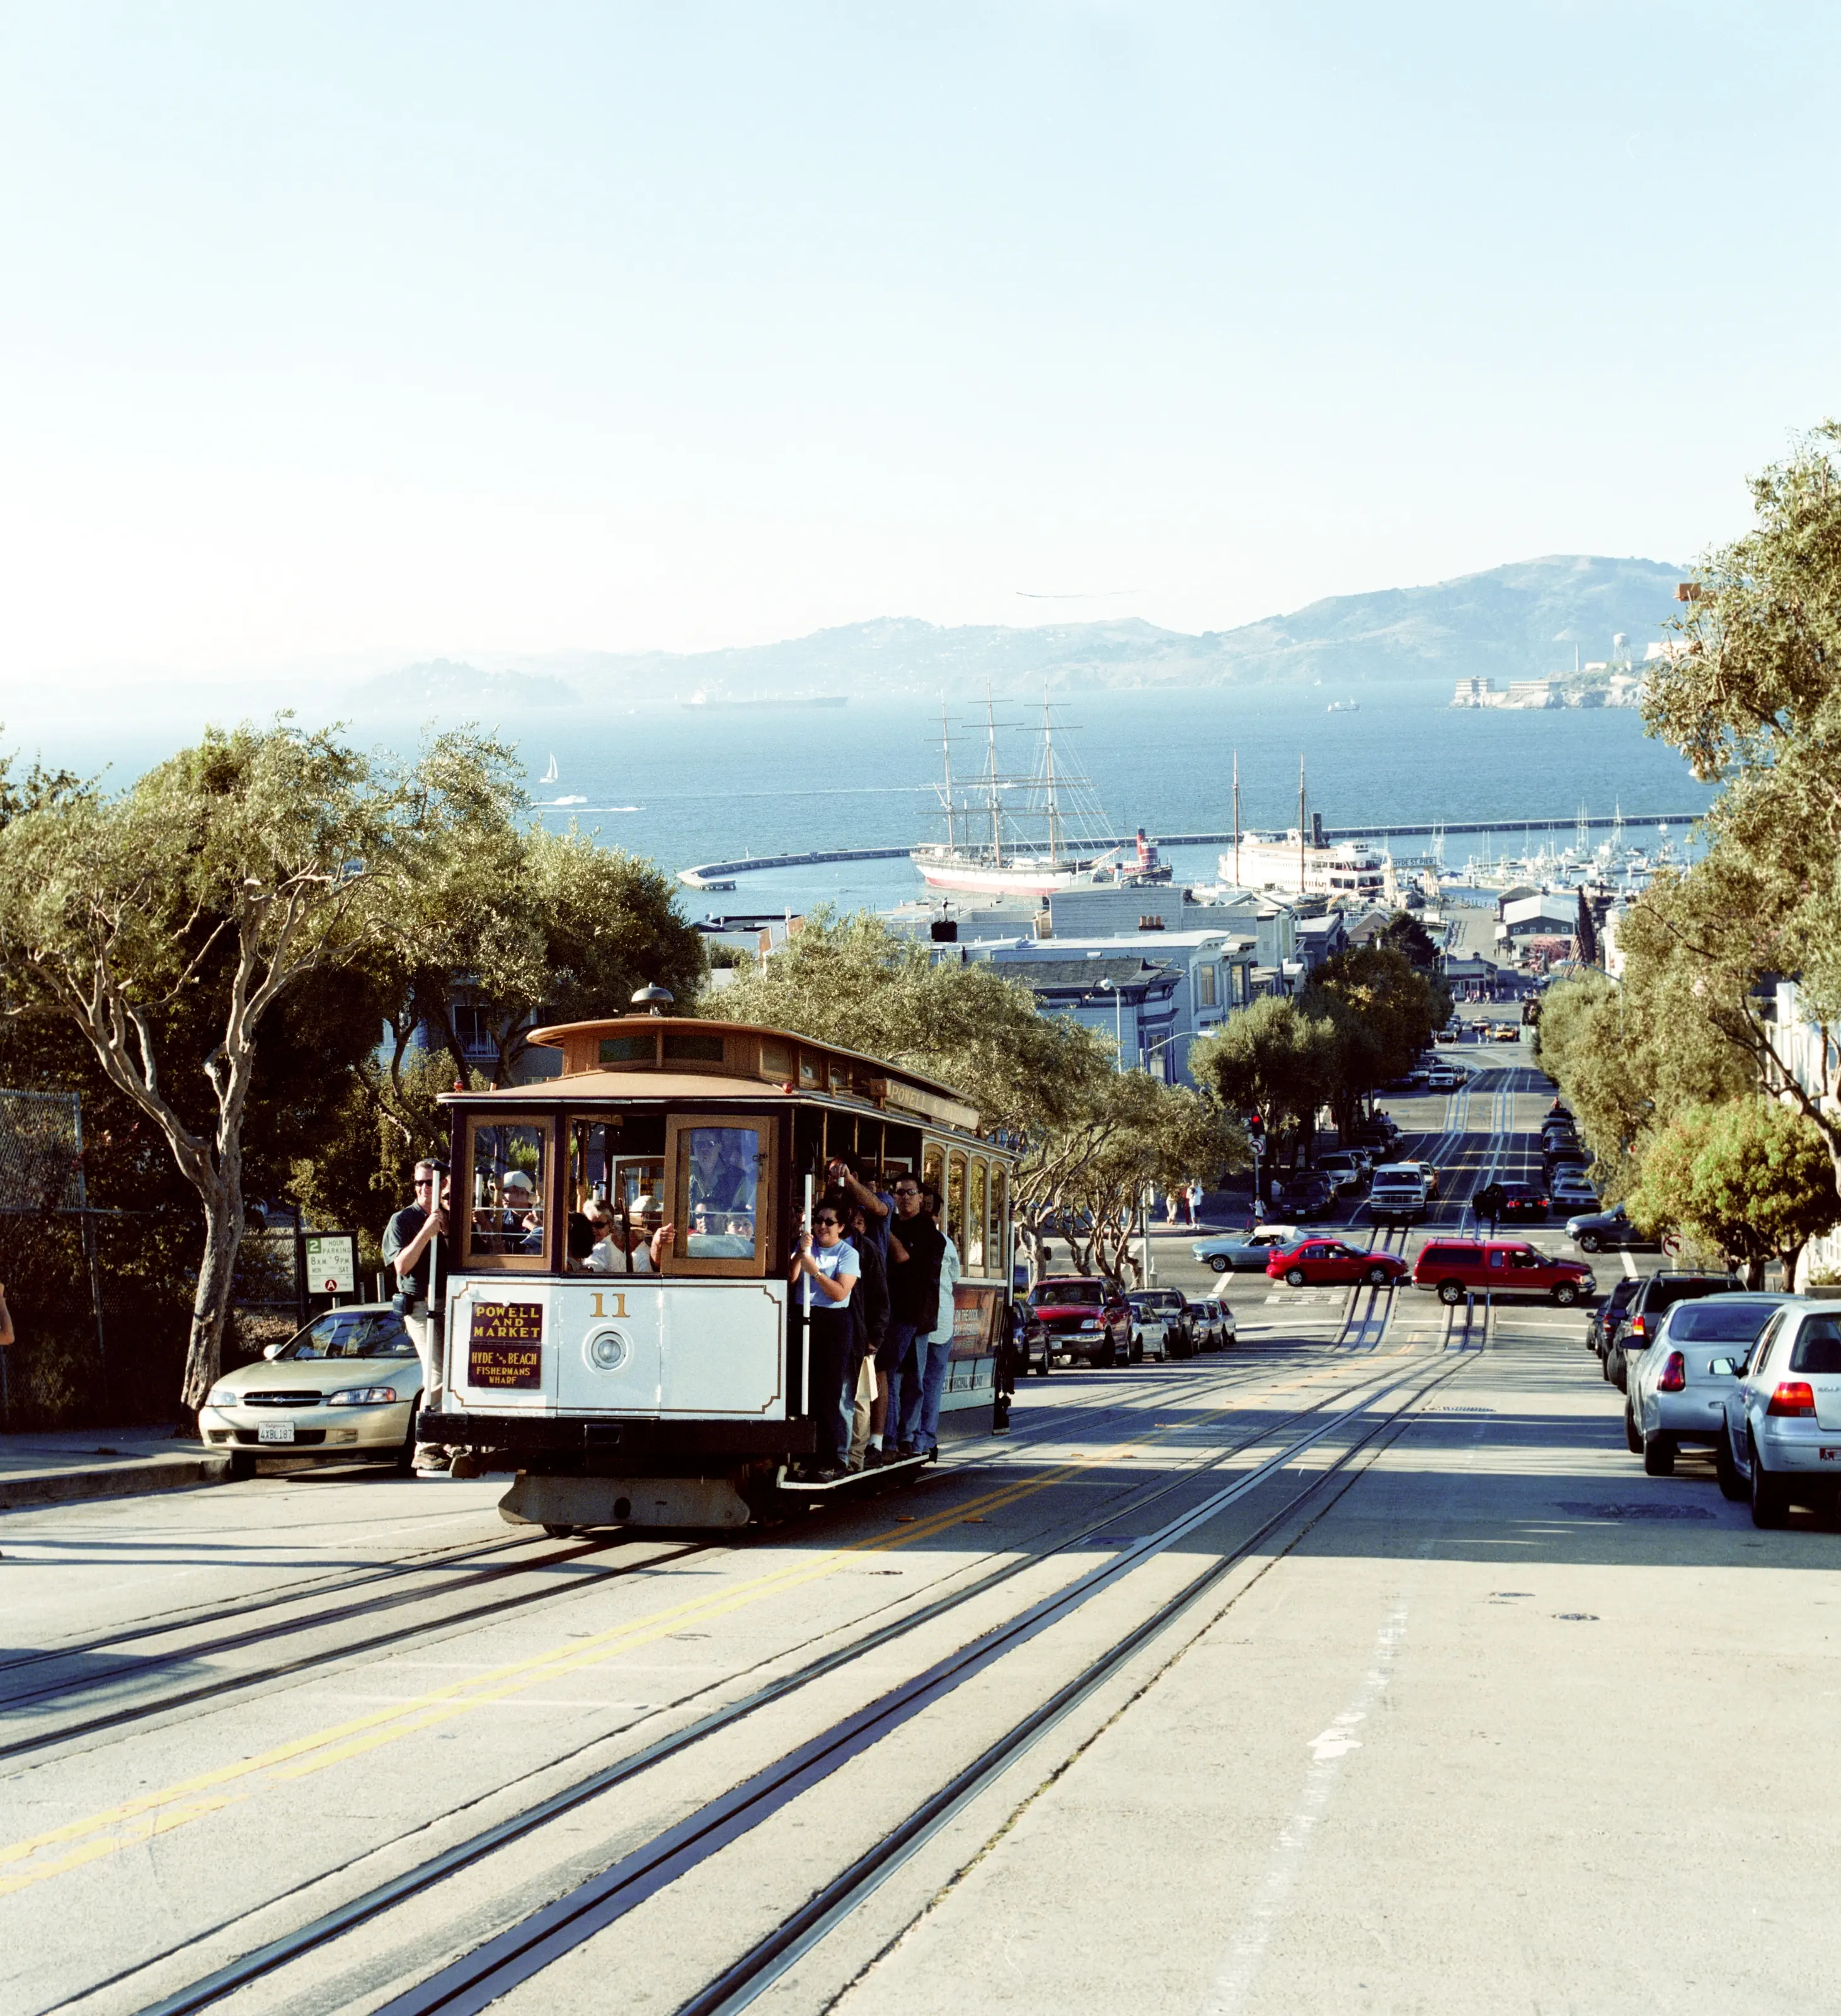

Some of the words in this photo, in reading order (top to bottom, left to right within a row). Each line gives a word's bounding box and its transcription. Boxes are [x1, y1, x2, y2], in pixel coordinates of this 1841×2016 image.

[890, 1085, 926, 1111] POWELL
[309, 1240, 319, 1252] 2
[327, 1280, 335, 1289] A
[590, 1293, 631, 1318] 11
[476, 1307, 539, 1318] POWELL
[491, 1318, 524, 1326] AND
[474, 1326, 540, 1337] MARKET
[472, 1352, 494, 1364] HYDE
[496, 1353, 506, 1364] AND
[508, 1353, 537, 1365] BEACH
[476, 1366, 531, 1376] FISHERMANS
[489, 1376, 517, 1384] WHARF
